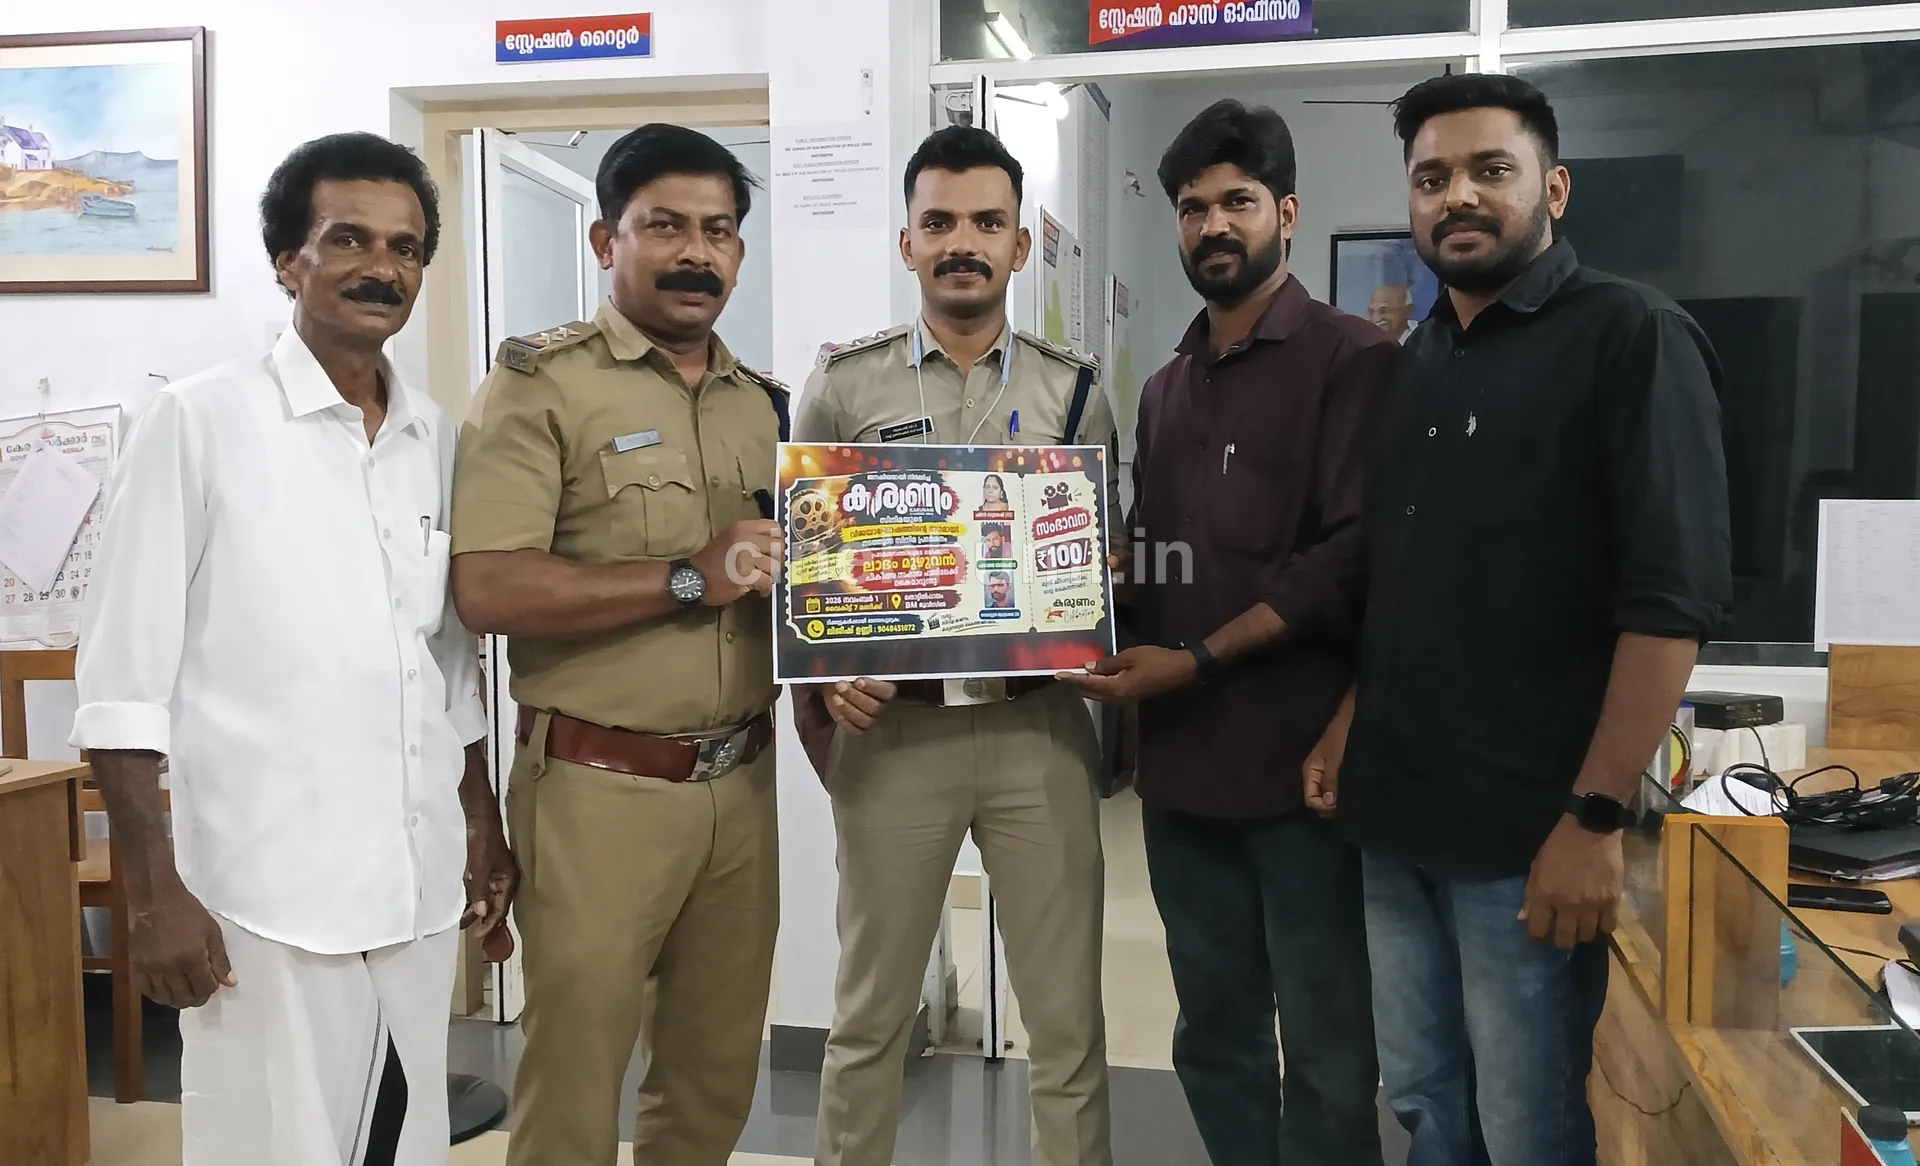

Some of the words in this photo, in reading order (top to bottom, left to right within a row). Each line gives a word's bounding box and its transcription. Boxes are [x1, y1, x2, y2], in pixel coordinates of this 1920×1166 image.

[1099, 3, 1162, 34] സ്റ്റേഷൻ
[505, 29, 573, 54] സ്റ്റേഷൻ
[580, 26, 640, 50] റൈറ്റർ
[842, 482, 952, 518] കരുണം
[1036, 512, 1088, 536] സംഭാവന
[69, 552, 80, 562] 17
[862, 559, 898, 572] ലാഭം
[902, 554, 956, 570] മുഴുവൻ
[1036, 541, 1092, 569] ₹100/-
[4, 578, 15, 588] 20
[4, 594, 16, 604] 27
[23, 592, 34, 602] 28
[55, 588, 66, 598] 30
[1053, 598, 1096, 608] കരുണം
